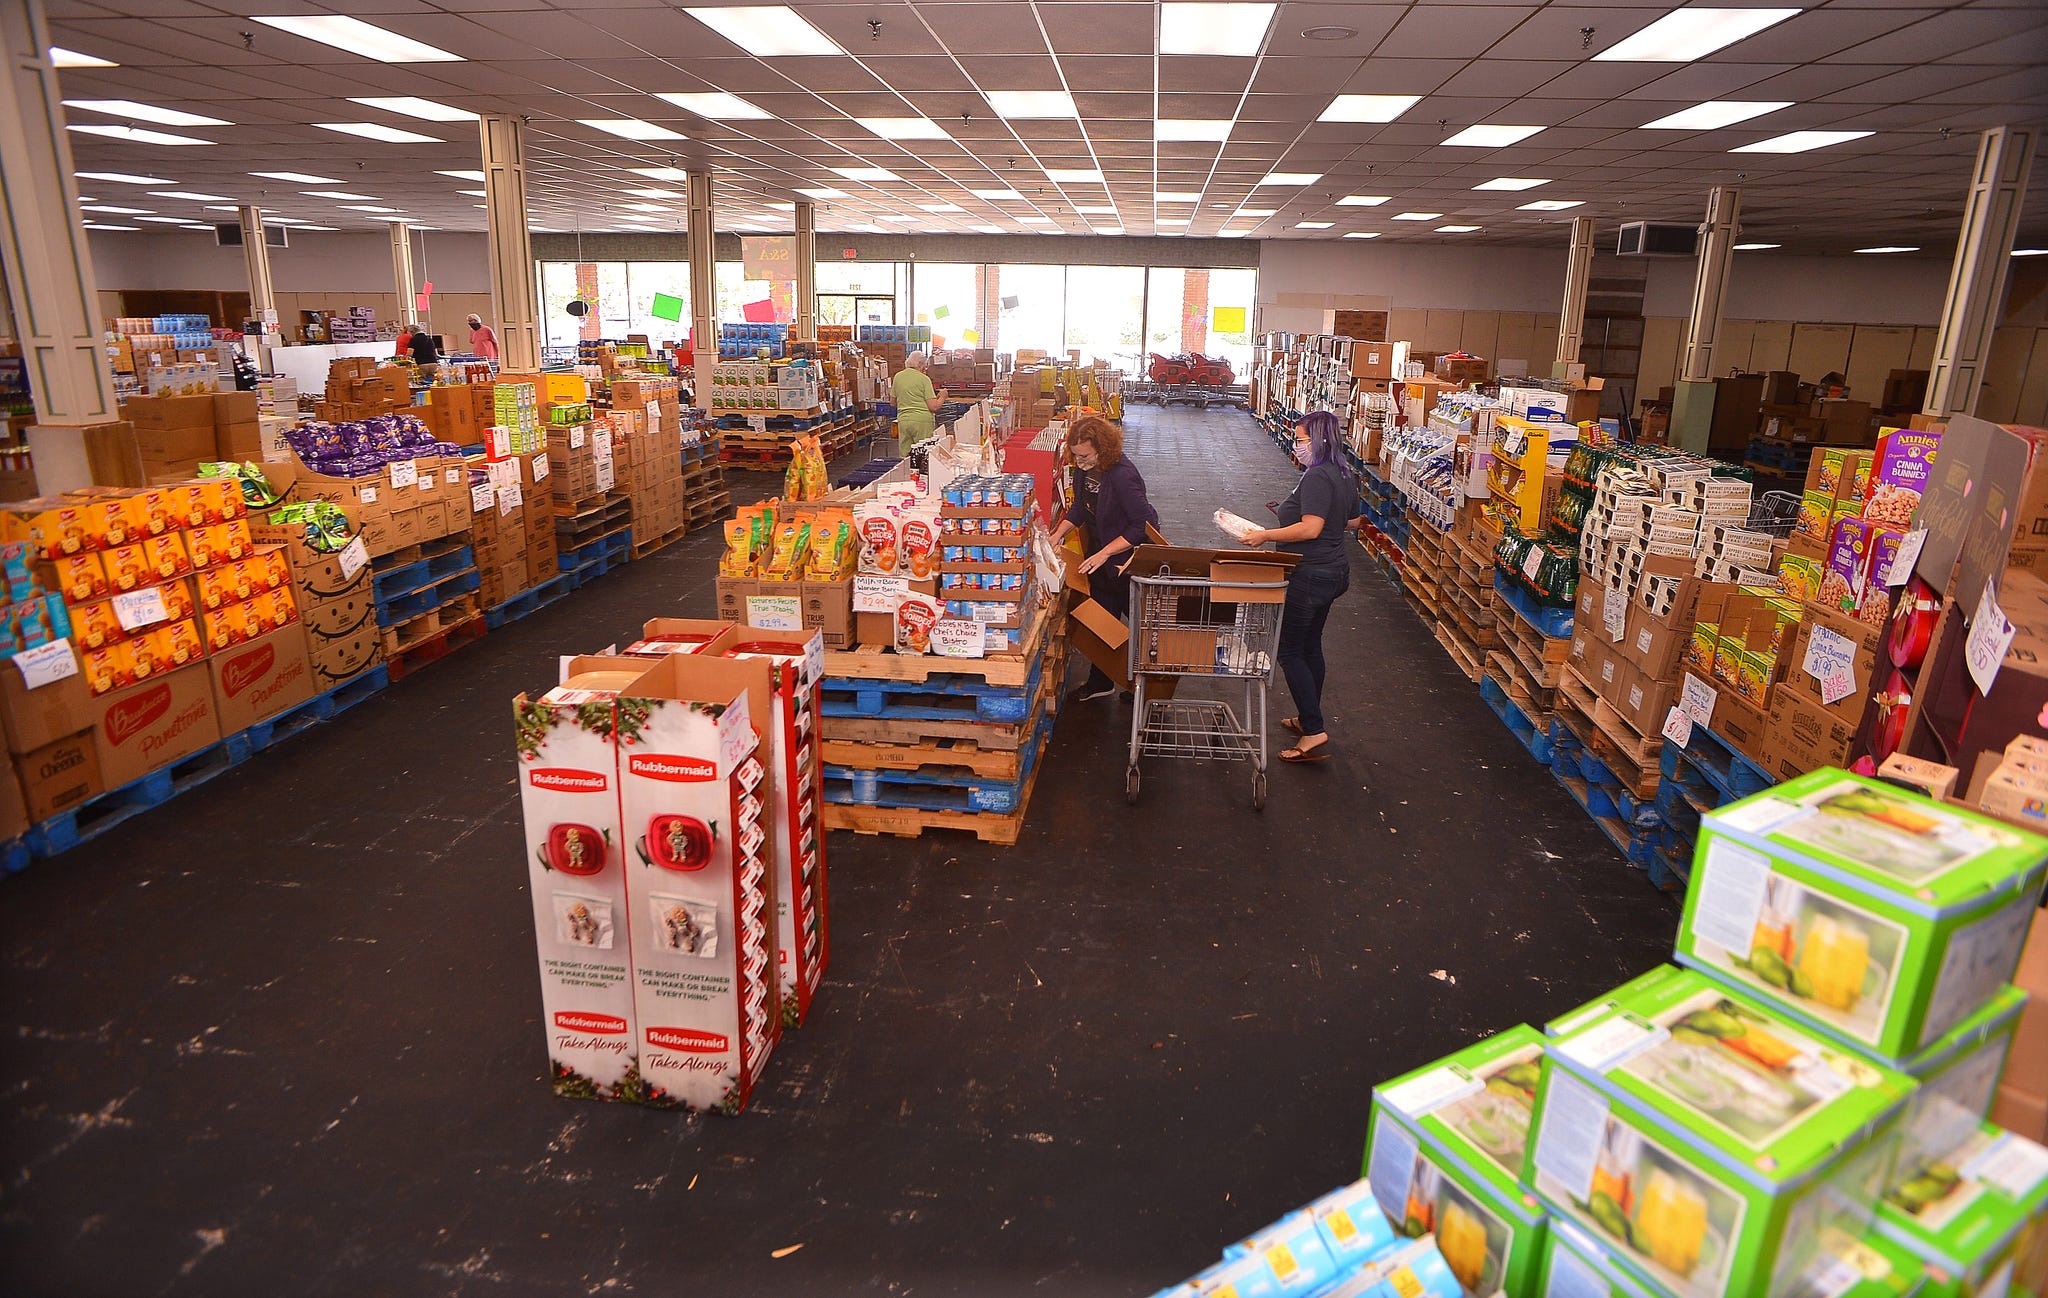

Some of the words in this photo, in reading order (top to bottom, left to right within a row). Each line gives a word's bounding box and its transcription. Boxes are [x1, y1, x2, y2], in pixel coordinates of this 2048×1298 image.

[1897, 434, 1939, 449] Annie's
[1896, 460, 1923, 471] CINNA
[1892, 468, 1927, 479] BUNNIES
[942, 637, 967, 645] Bistro
[1813, 624, 1841, 644] Organic
[632, 760, 713, 776] Rubbermaid
[532, 773, 605, 787] Rubbermaid
[549, 968, 564, 976] CAN
[565, 970, 586, 978] MAKE
[600, 973, 626, 982] BREAK
[583, 963, 626, 973] CONTAINER
[638, 968, 653, 976] THE
[655, 969, 680, 979] RIGHT
[682, 972, 730, 984] CONTAINER
[642, 978, 660, 987] CAN
[662, 980, 685, 989] MAKE
[687, 983, 700, 991] OR
[701, 984, 729, 993] BREAK
[557, 1016, 624, 1030] Rubbermaid
[650, 1031, 725, 1048] Rubbermaid
